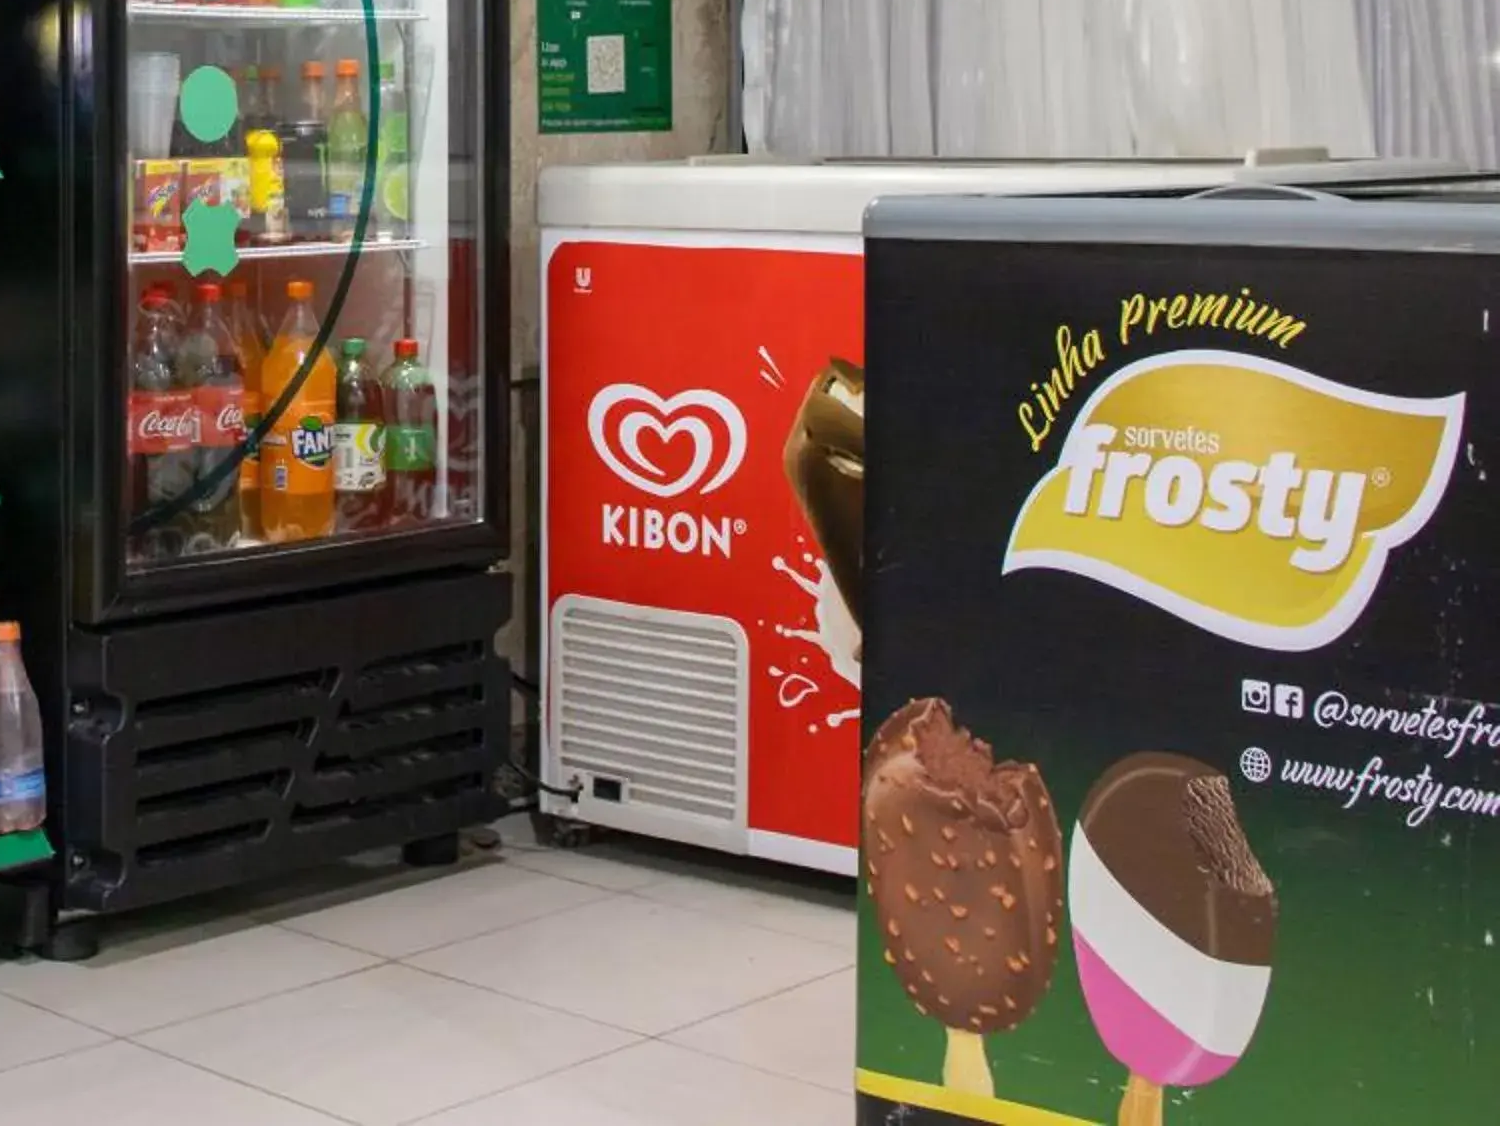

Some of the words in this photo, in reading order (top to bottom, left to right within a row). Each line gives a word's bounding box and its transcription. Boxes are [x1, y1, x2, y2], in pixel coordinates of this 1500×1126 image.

[1019, 325, 1106, 452] Linha
[1124, 425, 1221, 454] sorvetes
[602, 504, 731, 559] KIBON
[1063, 423, 1364, 573] frosty
